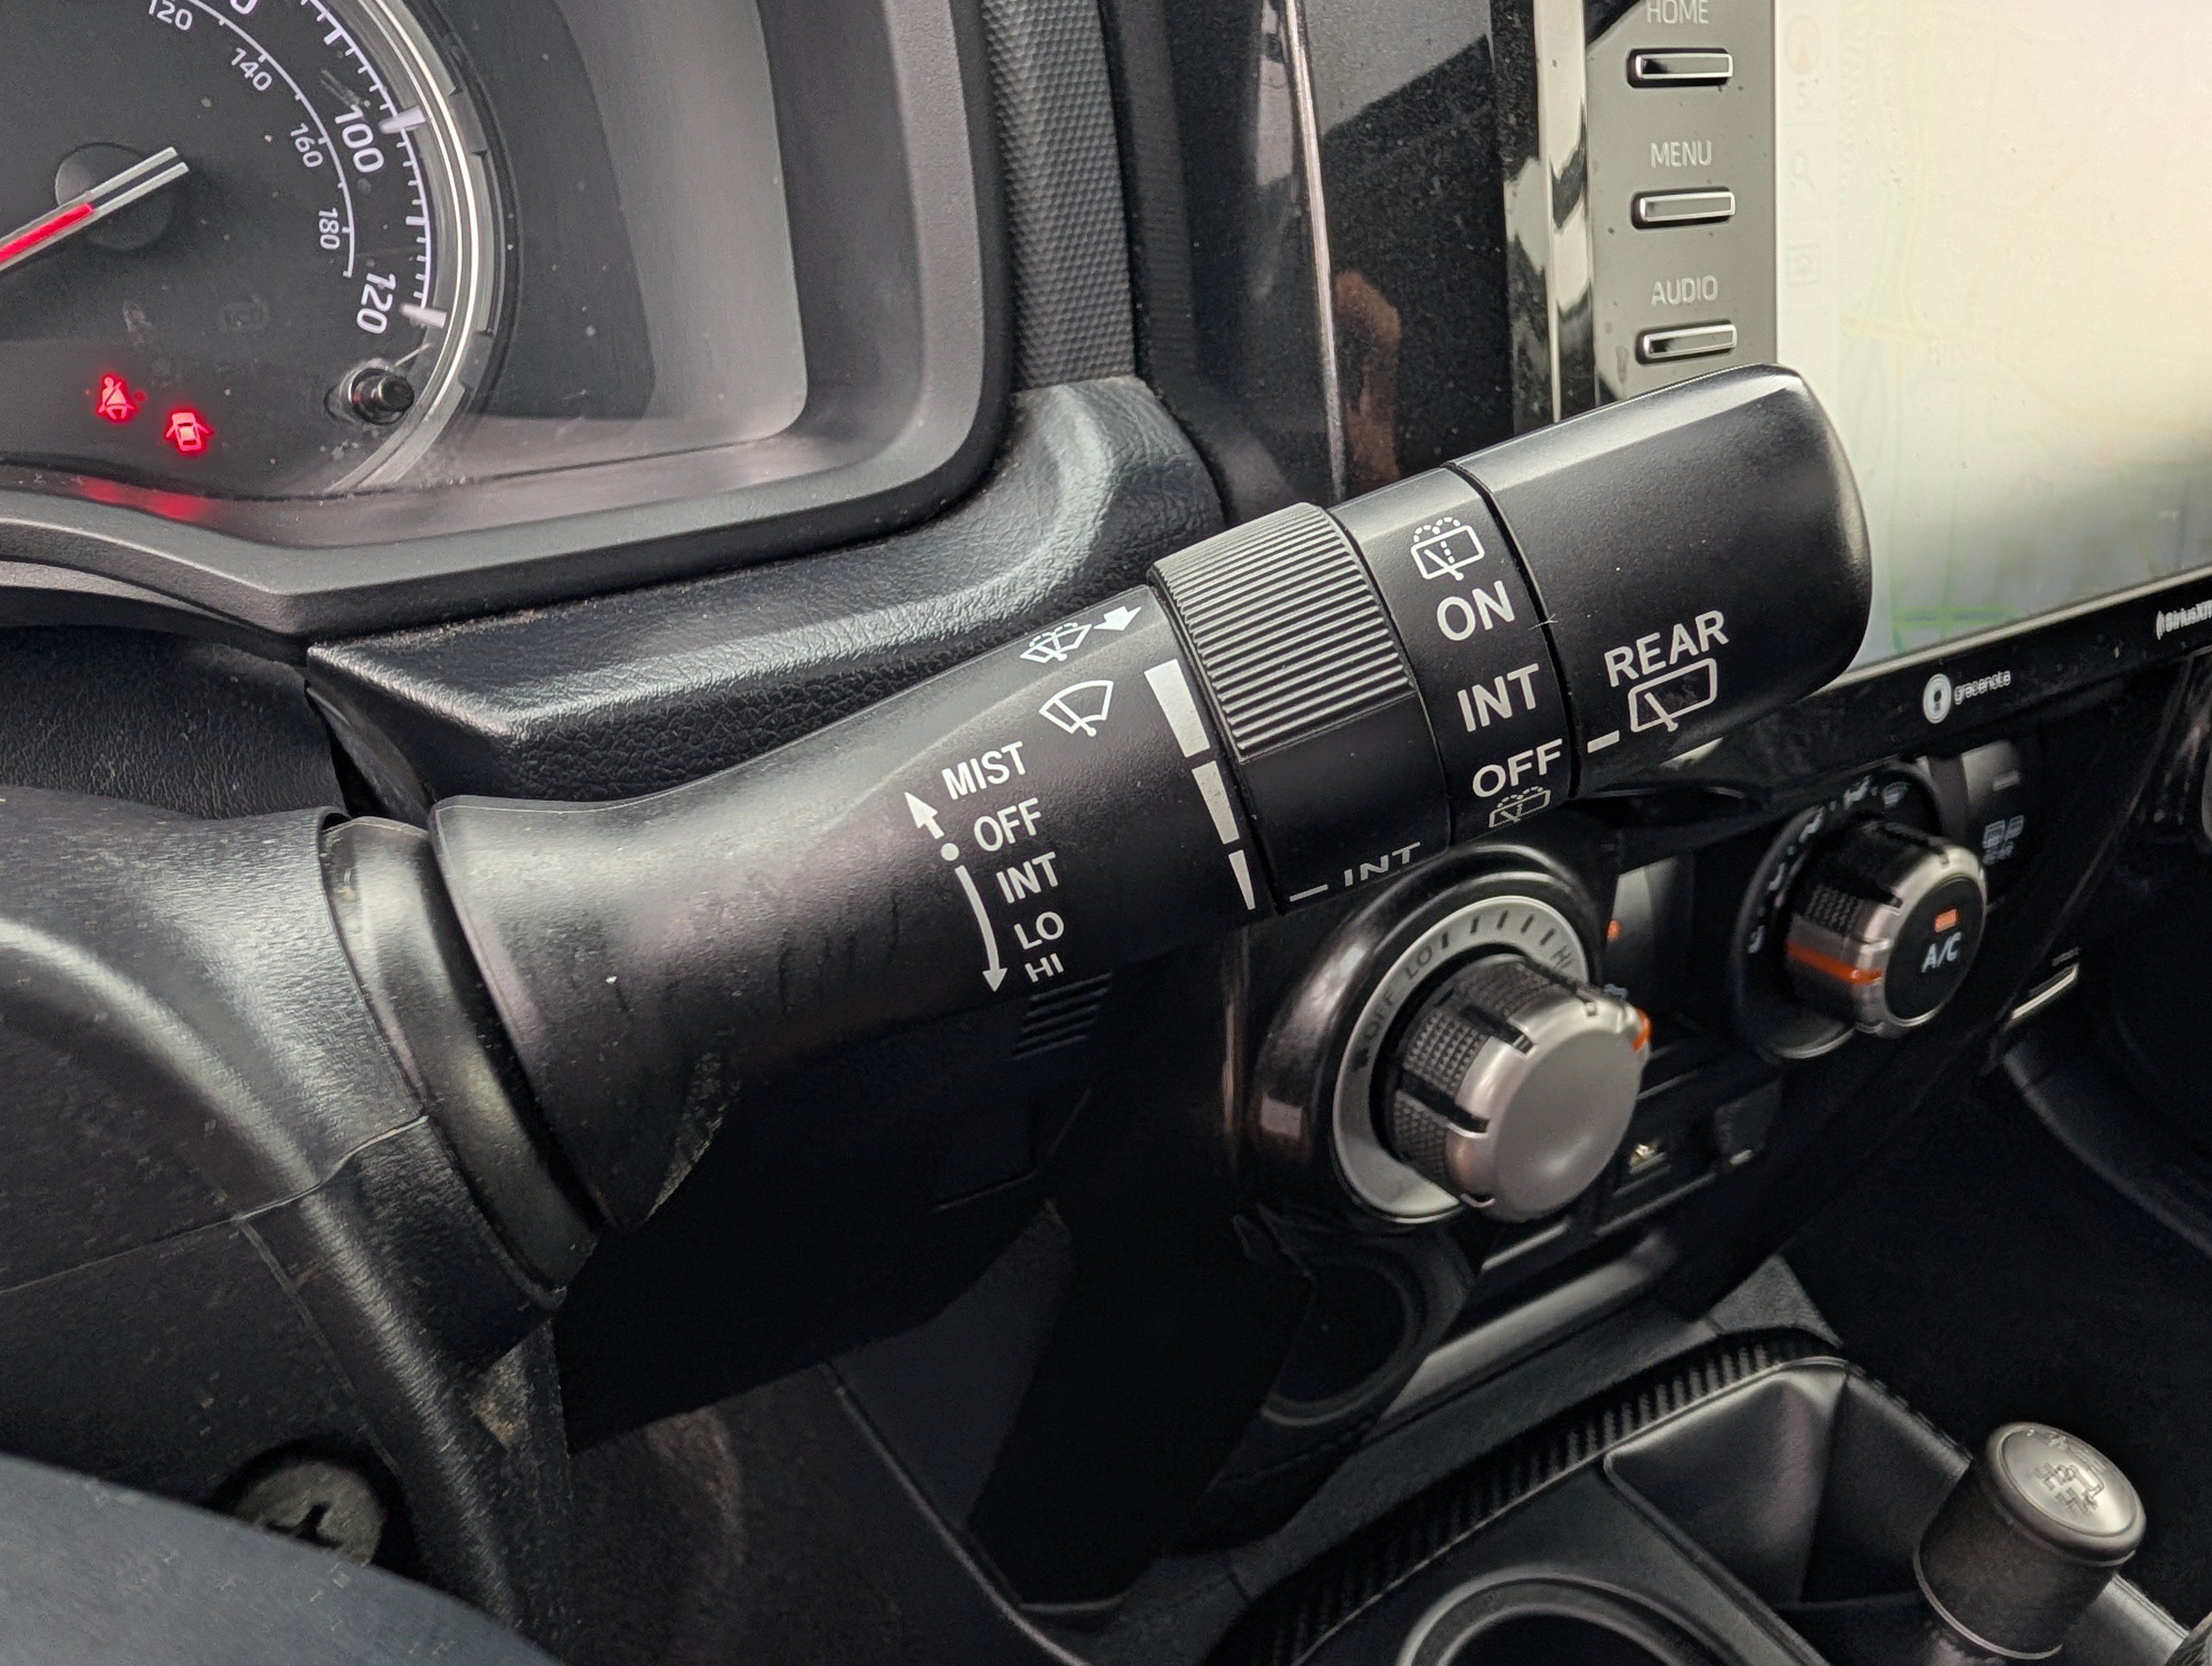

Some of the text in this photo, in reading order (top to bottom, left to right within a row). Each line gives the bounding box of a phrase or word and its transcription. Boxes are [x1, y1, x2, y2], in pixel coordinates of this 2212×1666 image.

[149, 0, 193, 30] 120
[1647, 0, 1710, 24] HOME
[231, 47, 272, 91] 140
[290, 123, 324, 168] 160
[335, 104, 384, 173] 100
[1650, 140, 1712, 168] MENU
[318, 207, 340, 251] 180
[357, 273, 396, 334] 120
[1651, 275, 1718, 306] AUDIO
[1436, 580, 1516, 641] ON
[1604, 610, 1729, 688] REAR
[1457, 663, 1540, 732] INT
[942, 741, 1027, 800] MIST
[1472, 739, 1562, 798] OFF
[974, 798, 1041, 852] OFF
[996, 851, 1059, 904] INT
[1343, 842, 1421, 887] INT
[1014, 911, 1064, 950] LO
[1921, 931, 1964, 973] A/C
[1025, 953, 1064, 983] HI
[1404, 945, 1433, 979] LO
